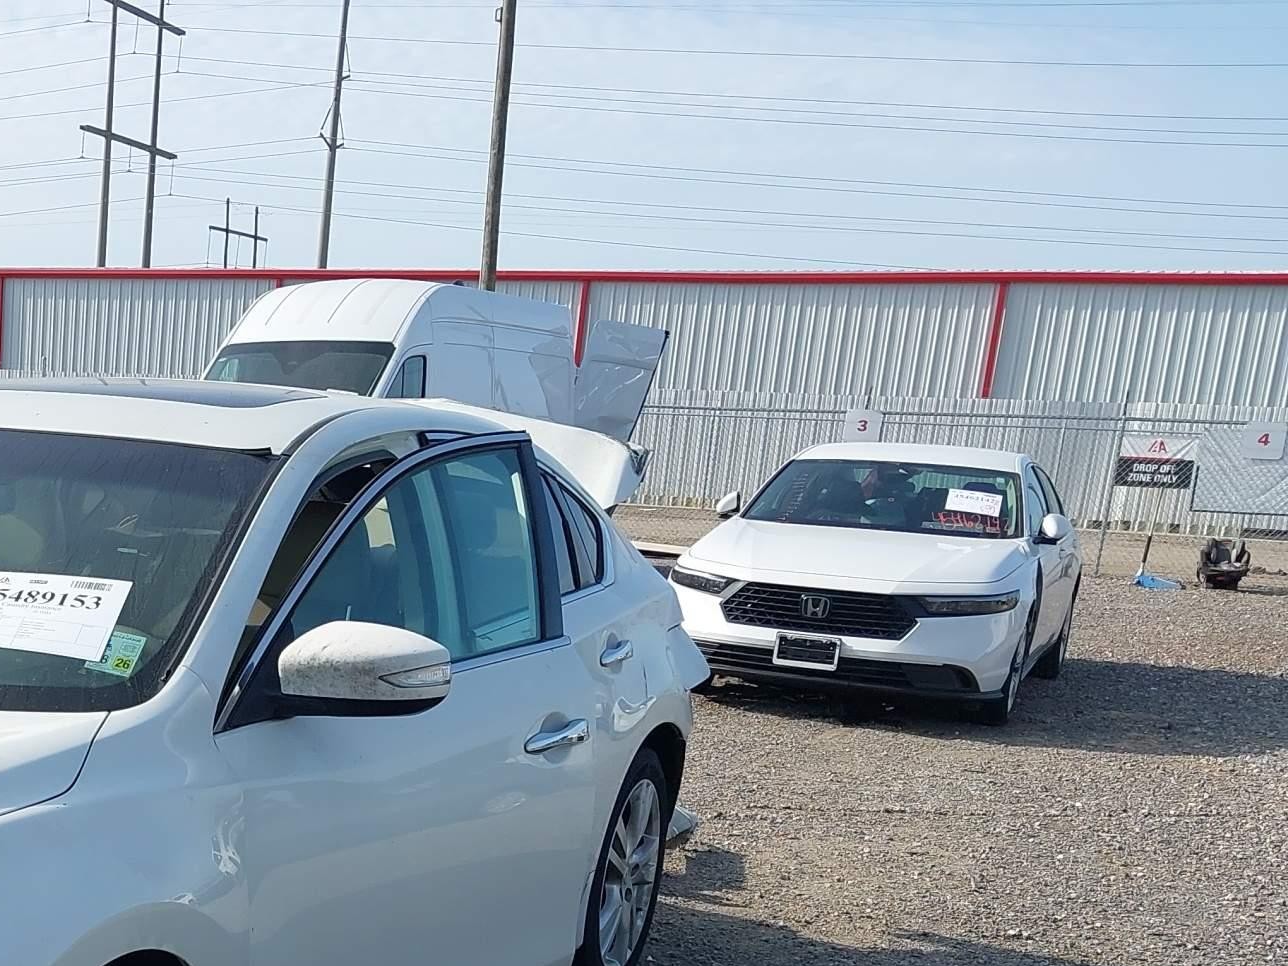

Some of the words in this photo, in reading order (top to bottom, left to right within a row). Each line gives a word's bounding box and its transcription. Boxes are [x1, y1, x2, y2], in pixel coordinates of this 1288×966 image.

[857, 420, 868, 431] 3
[1257, 433, 1271, 446] 4
[1133, 463, 1158, 472] DROP
[1127, 473, 1152, 482] ZONE
[1154, 475, 1178, 484] ONLY
[115, 658, 131, 669] 26
